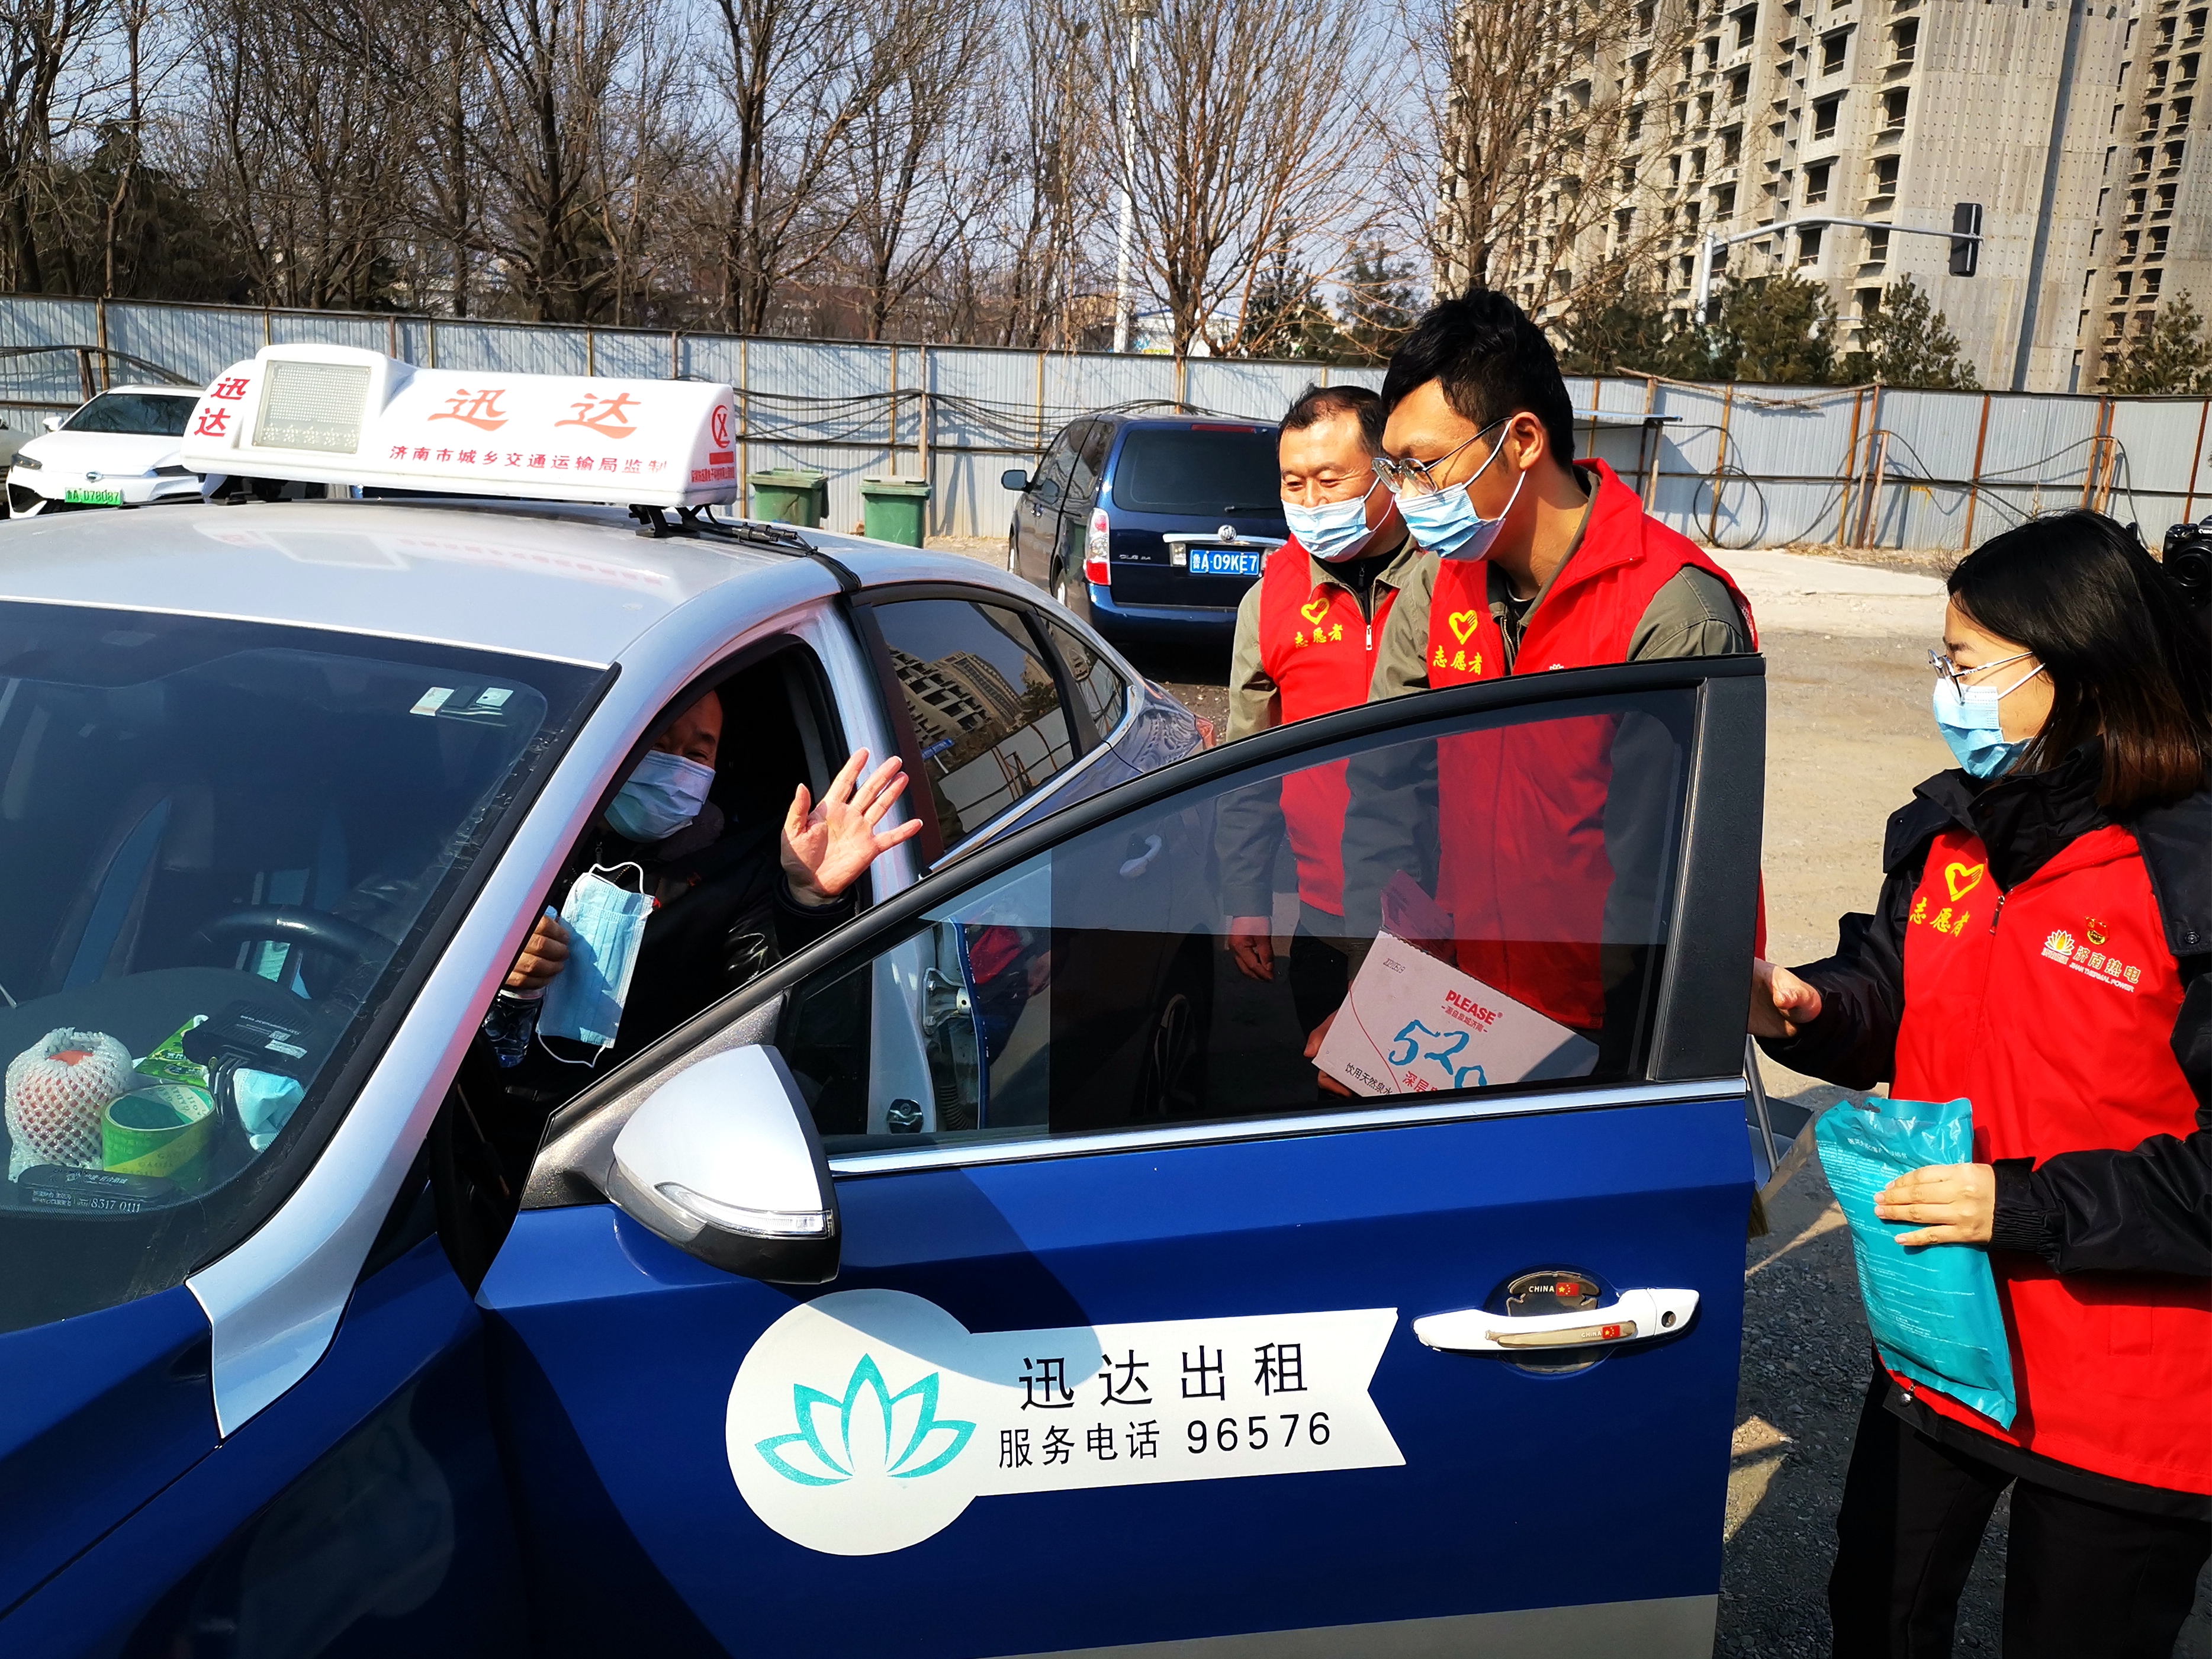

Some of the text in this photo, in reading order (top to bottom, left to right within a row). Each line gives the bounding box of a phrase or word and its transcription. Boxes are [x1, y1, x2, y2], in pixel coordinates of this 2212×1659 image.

[194, 377, 250, 437] 迅达
[427, 388, 642, 439] 迅达
[389, 445, 667, 474] 济南市城乡交通运输局监制
[1294, 623, 1343, 649] 志愿者
[1433, 645, 1483, 675] 志愿者
[1909, 896, 1970, 937] 志愿者
[2073, 946, 2141, 984] 济南热电
[2111, 979, 2134, 992] POWER
[1445, 989, 1497, 1025] PLEASE
[1345, 1062, 1393, 1095] 饮用天然泉水
[1019, 1342, 1308, 1411] 迅达出租
[999, 1412, 1330, 1469] 服务电话 96576
